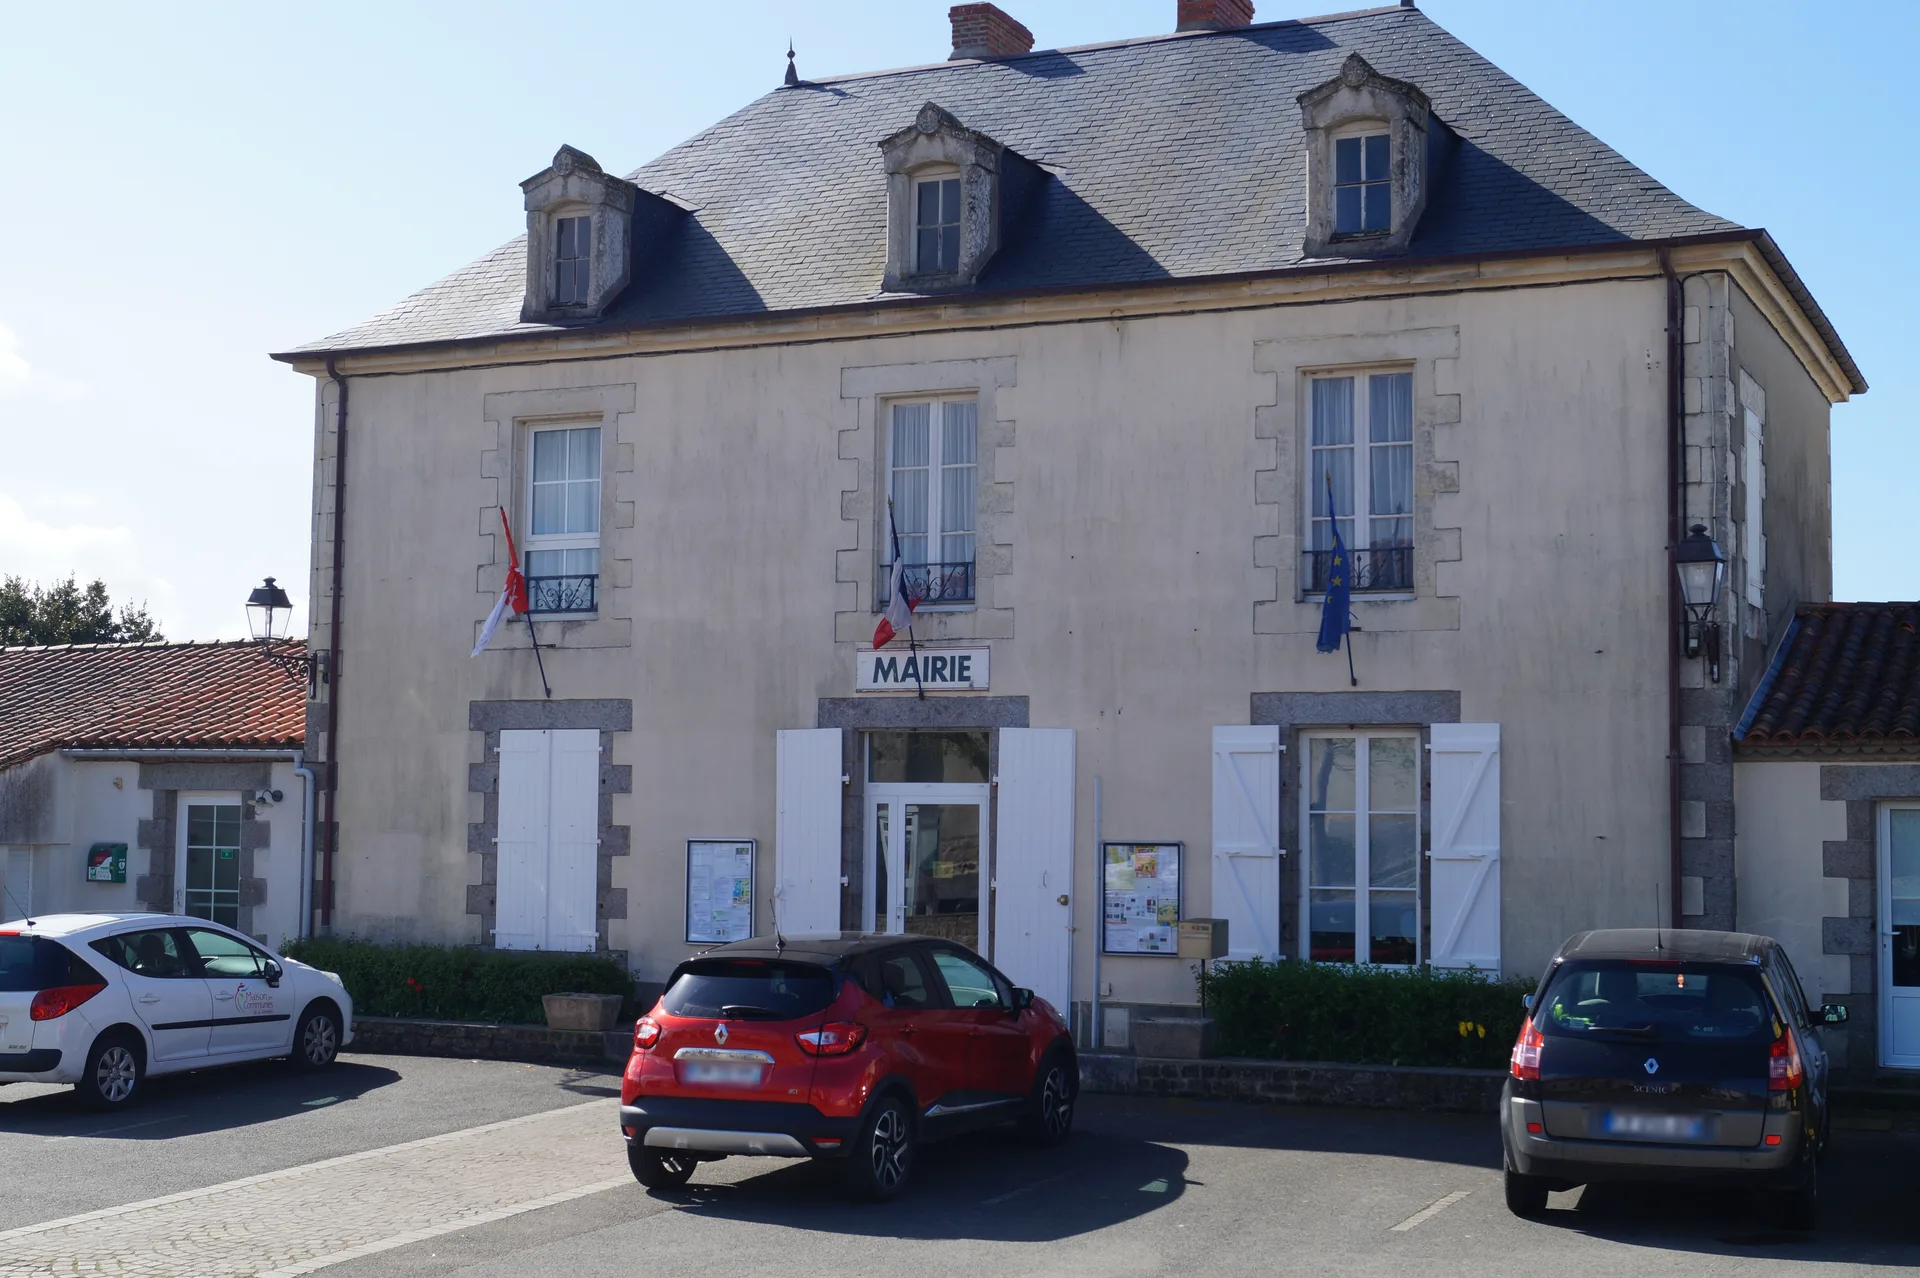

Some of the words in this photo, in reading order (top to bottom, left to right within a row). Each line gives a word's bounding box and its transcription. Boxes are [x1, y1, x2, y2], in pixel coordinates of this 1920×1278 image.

[872, 655, 971, 683] MAIRIE
[245, 992, 268, 1001] Maison
[243, 1001, 274, 1010] Communes
